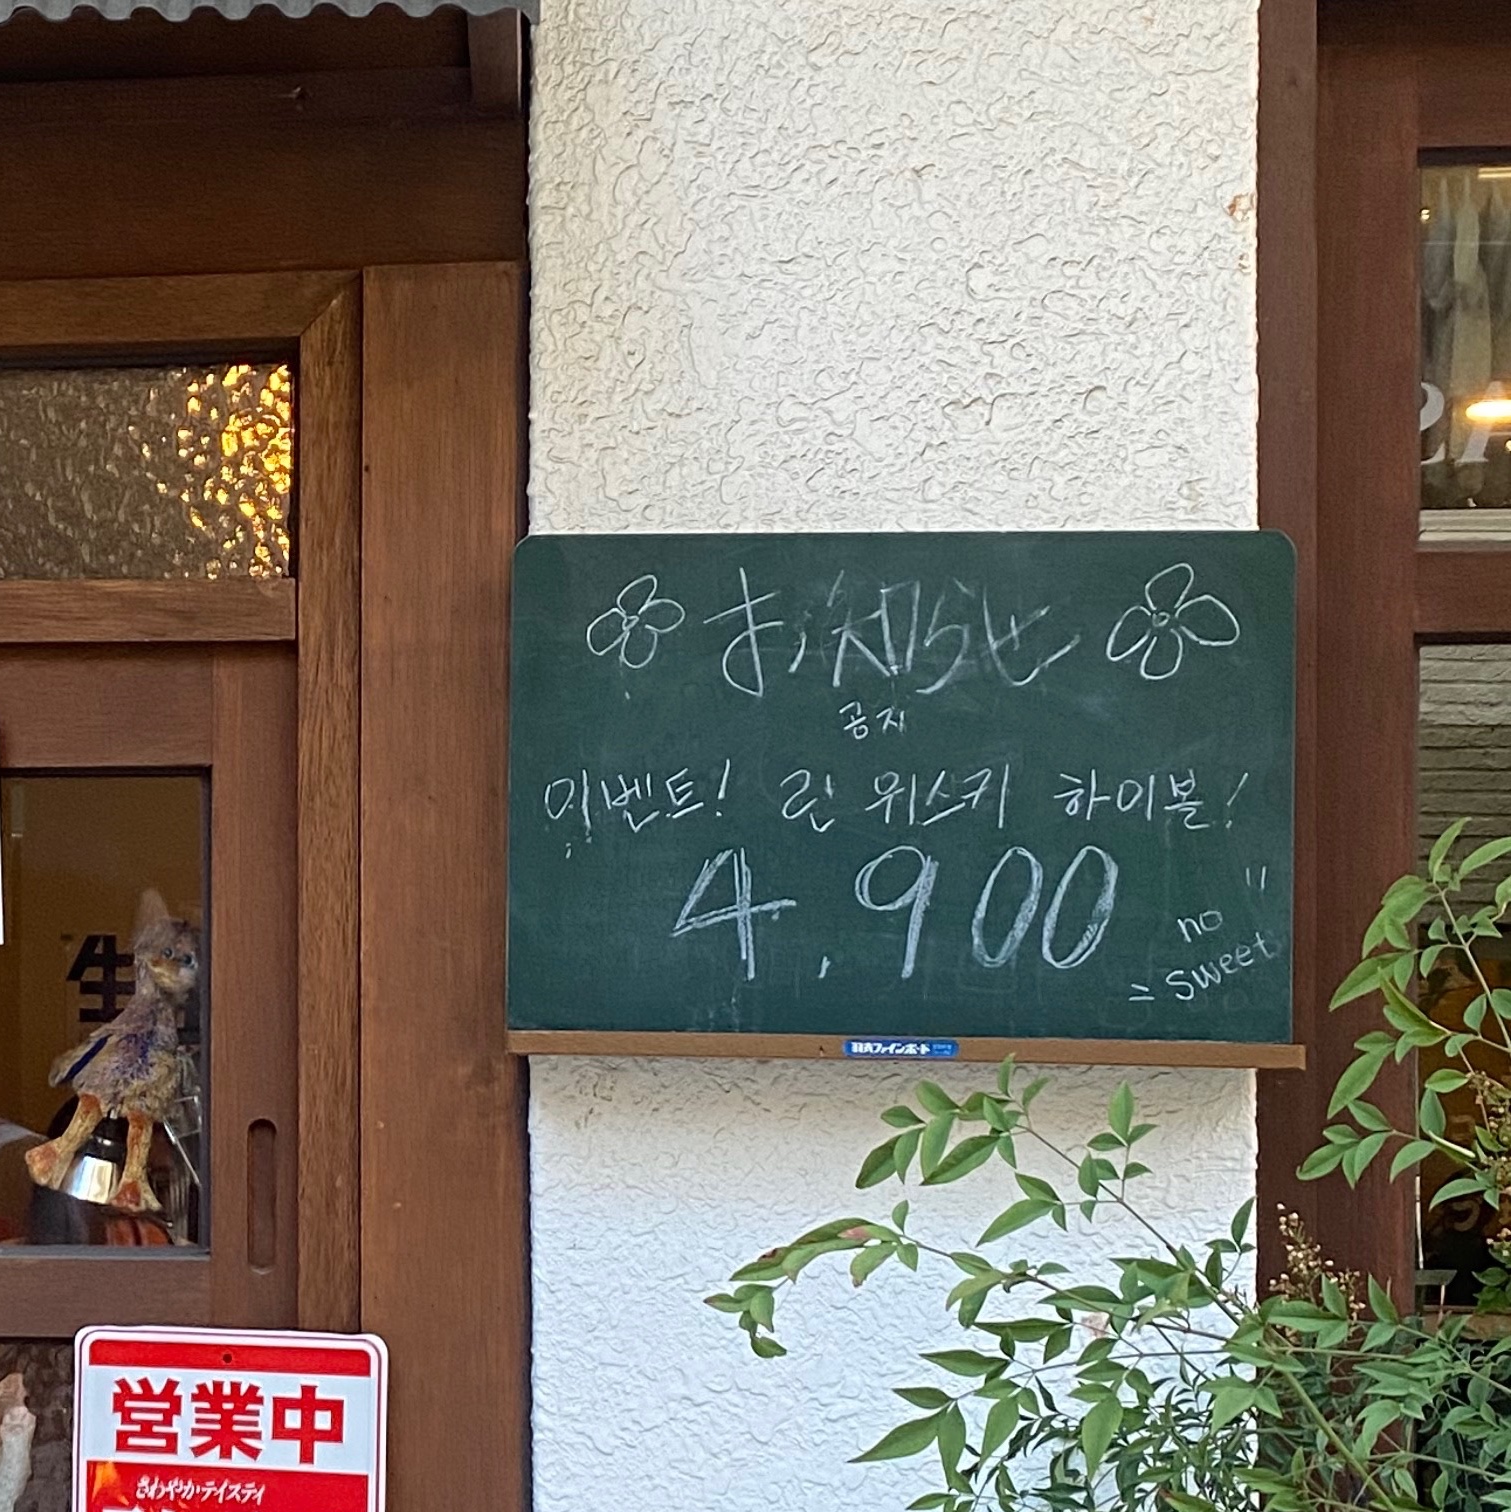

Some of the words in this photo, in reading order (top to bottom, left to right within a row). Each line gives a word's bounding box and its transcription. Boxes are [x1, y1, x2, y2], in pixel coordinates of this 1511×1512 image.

[704, 567, 1081, 697] お知らせ
[838, 701, 906, 740] 공지
[544, 758, 731, 833] 이벤트!
[864, 763, 1009, 829] 위스키
[1053, 767, 1249, 830] 하이볼!
[1177, 910, 1223, 943] no
[112, 1377, 345, 1466] 営業中
